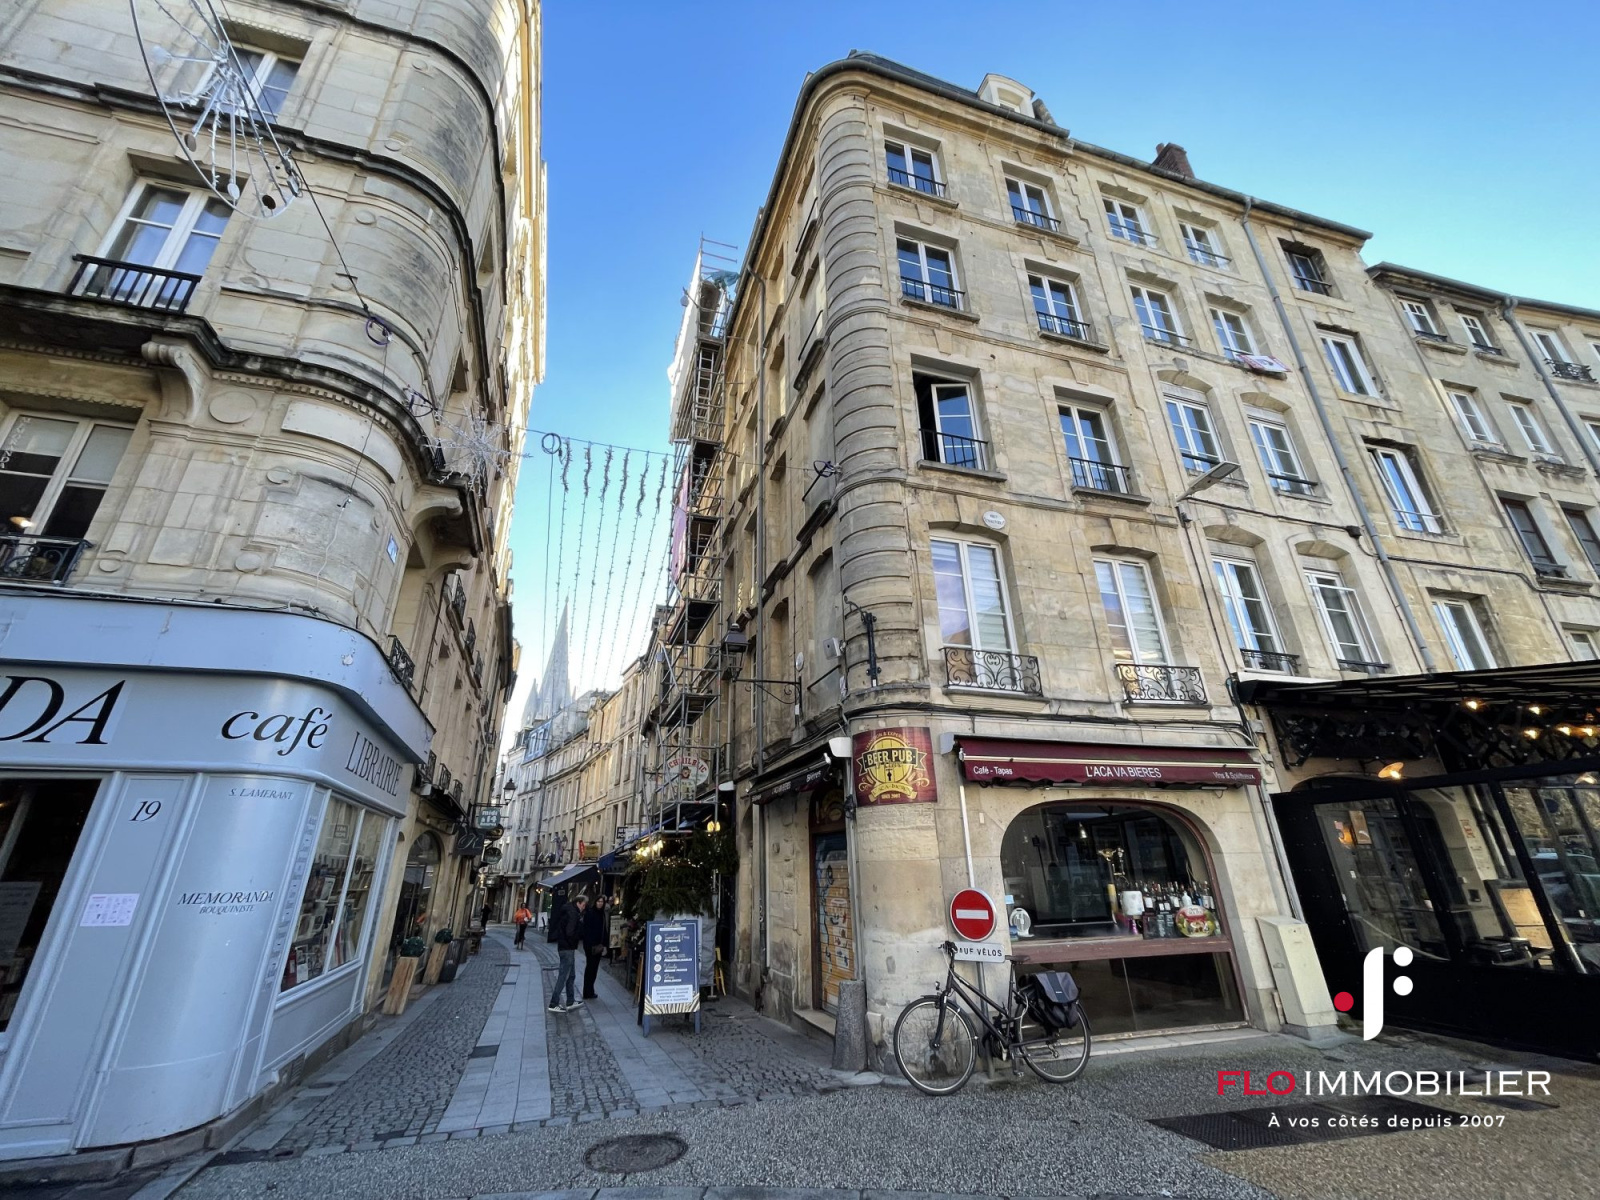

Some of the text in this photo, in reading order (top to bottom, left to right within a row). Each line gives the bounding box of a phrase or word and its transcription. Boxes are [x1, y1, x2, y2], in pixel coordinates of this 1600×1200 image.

[221, 707, 333, 756] café
[344, 731, 403, 797] LIBRAIRIE
[866, 750, 889, 766] BEER
[892, 749, 913, 762] PUB
[973, 765, 990, 775] Café
[993, 766, 1013, 776] Tapas
[1085, 765, 1162, 779] L'ACA VA BIERES
[239, 787, 294, 800] LAMERANT
[129, 800, 162, 822] 19
[177, 890, 274, 905] MEMORANDA
[199, 904, 255, 915] BOUQUINISTE
[976, 947, 1003, 957] VÉLOS
